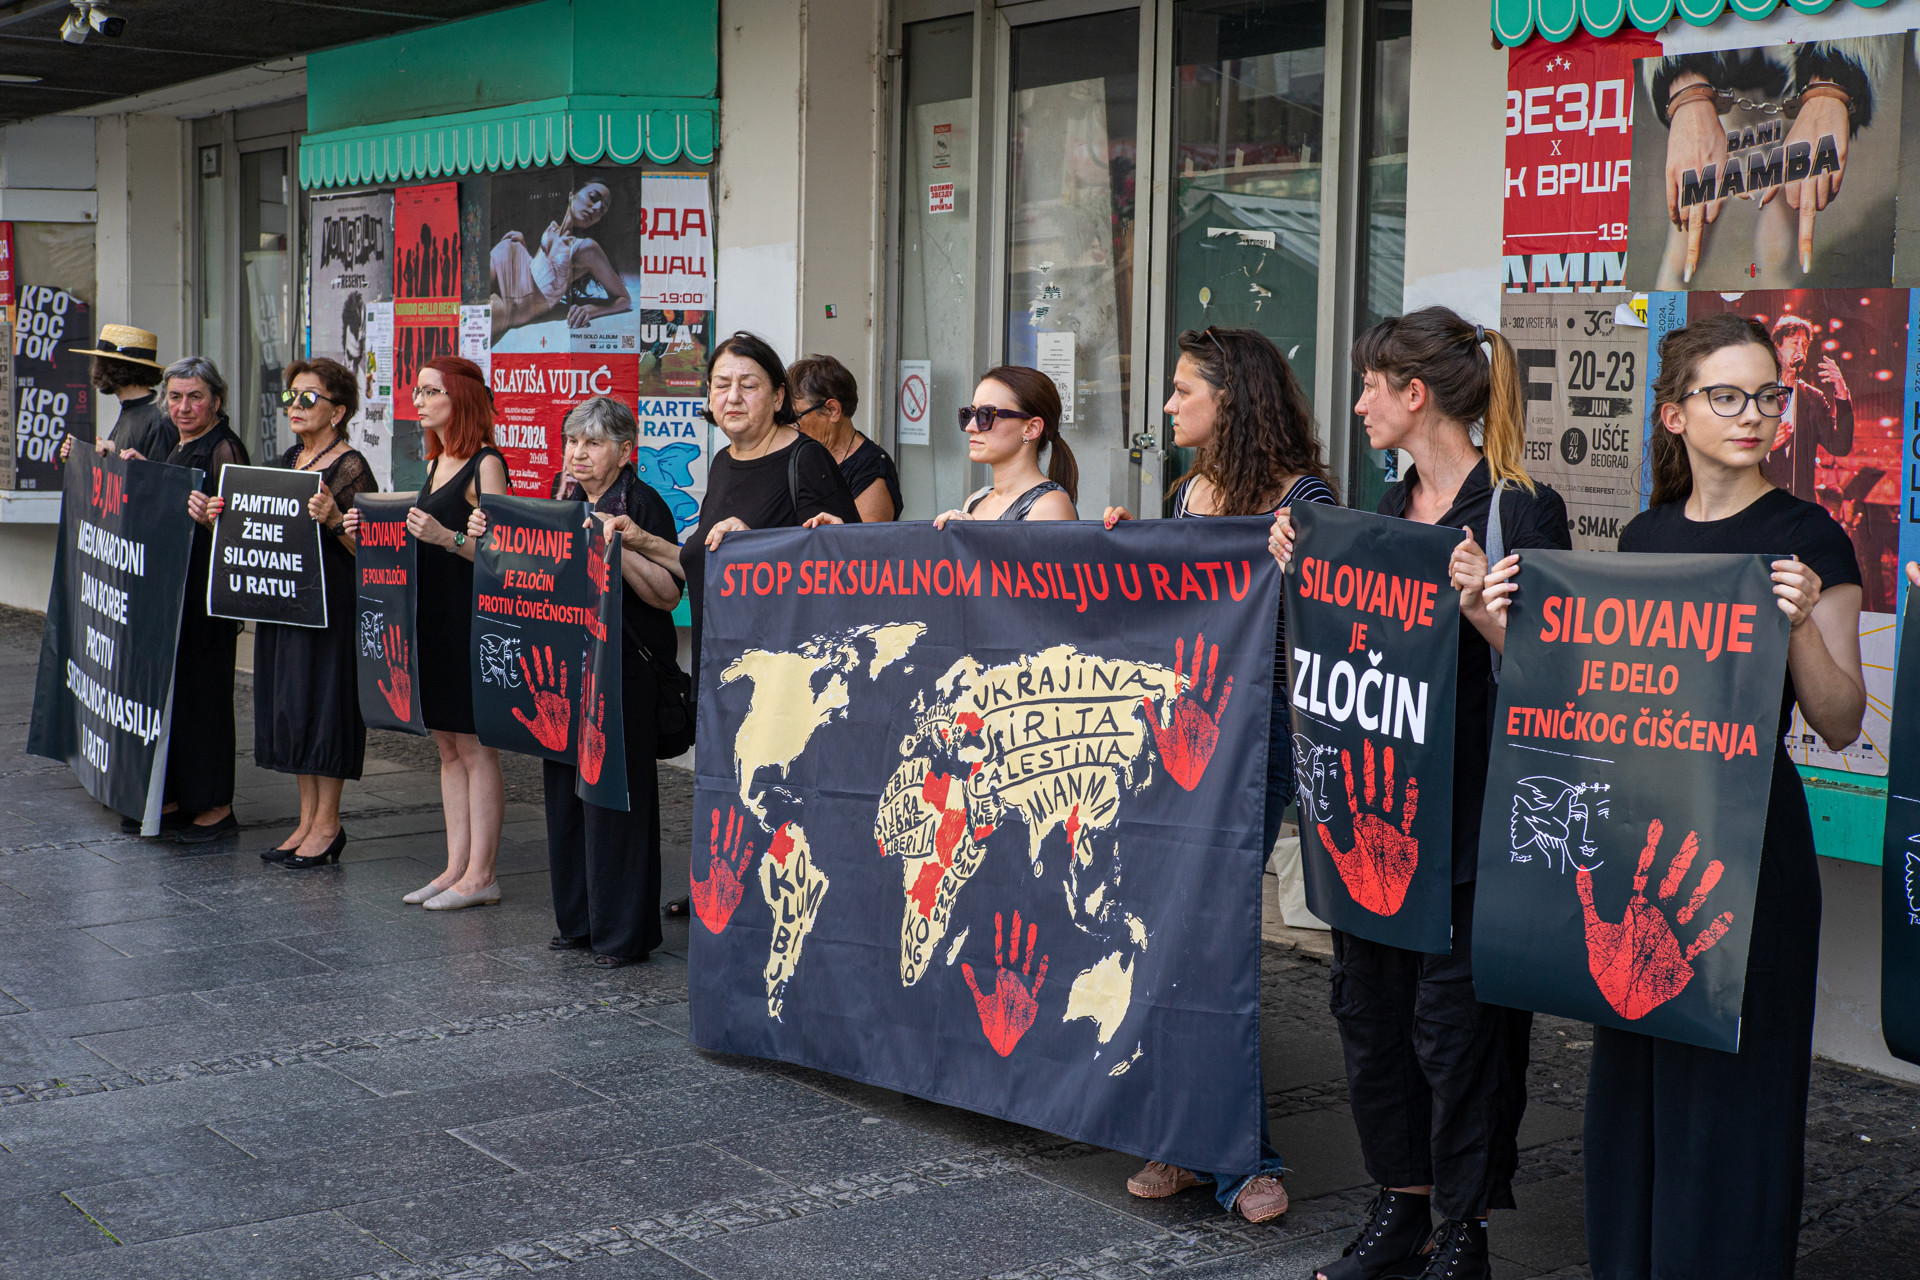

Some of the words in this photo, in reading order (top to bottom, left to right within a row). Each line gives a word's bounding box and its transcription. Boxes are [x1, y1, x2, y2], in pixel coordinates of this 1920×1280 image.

[1727, 119, 1782, 153] BANI
[1681, 134, 1840, 208] MAMBA
[321, 214, 385, 270] YUNGBLUD
[20, 285, 69, 315] КРО
[16, 307, 65, 339] ВОС
[1513, 316, 1525, 328] 302
[1525, 316, 1544, 328] VRSTE
[1658, 305, 1667, 332] 2024.
[15, 332, 58, 361] ТОК
[494, 364, 546, 394] SLAVIŠA
[548, 365, 612, 399] VUJIĆ
[1568, 350, 1636, 392] 20-23
[20, 388, 69, 416] КРО
[1588, 400, 1610, 417] JUN
[16, 410, 65, 440] ВОС
[494, 424, 548, 450] 06.07.2024.
[644, 421, 696, 438] RATA
[1569, 432, 1579, 446] 20
[1592, 423, 1630, 453] UŠĆE
[16, 433, 60, 462] ТОК
[1524, 441, 1553, 461] FEST
[1568, 446, 1579, 461] 24
[1590, 454, 1629, 470] BEOGRAD
[231, 493, 300, 517] PAMTIMO
[242, 517, 284, 543] ŽENE
[360, 521, 407, 552] SILOVANJE
[490, 524, 574, 565] SILOVANJE
[78, 519, 145, 577] MEĐUNARODNI
[223, 546, 303, 572] SILOVANE
[229, 574, 242, 592] U
[246, 576, 297, 598] RATU!
[362, 567, 369, 587] JE
[369, 567, 385, 585] POLNI
[386, 564, 407, 585] ZLOČIN
[503, 569, 515, 590] JE
[516, 568, 555, 592] ZLOČIN
[721, 561, 792, 597] STOP
[797, 559, 981, 597] SEKSUALNOM
[991, 559, 1109, 613] NASILJU
[1115, 563, 1143, 601] U
[1148, 560, 1251, 602] RATU
[81, 571, 98, 608] DAN
[97, 579, 129, 626] BORBE
[478, 594, 514, 615] PROTIV
[515, 595, 584, 625] ČOVEČNOSTI
[1300, 556, 1438, 632] SILOVANJE
[1348, 622, 1369, 654] JE
[1540, 596, 1757, 662] SILOVANJE
[85, 625, 115, 671] PROTIV
[973, 655, 1148, 711] UKRAJINA
[1577, 660, 1606, 696] JE
[1610, 662, 1679, 695] DELO
[1292, 647, 1428, 744] ZLOČIN
[106, 692, 162, 747] NASILJA
[983, 706, 1119, 763] SIRIJA
[1507, 701, 1627, 744] ETNIČKOG
[1632, 706, 1758, 761] ČIŠĆENJA
[86, 729, 110, 774] RATU
[973, 740, 1130, 792] PALESTINA
[883, 760, 924, 802] LIBIJA
[875, 793, 924, 836] SIJERA
[883, 812, 922, 843] LEONE
[886, 820, 936, 855] LIBERIJA
